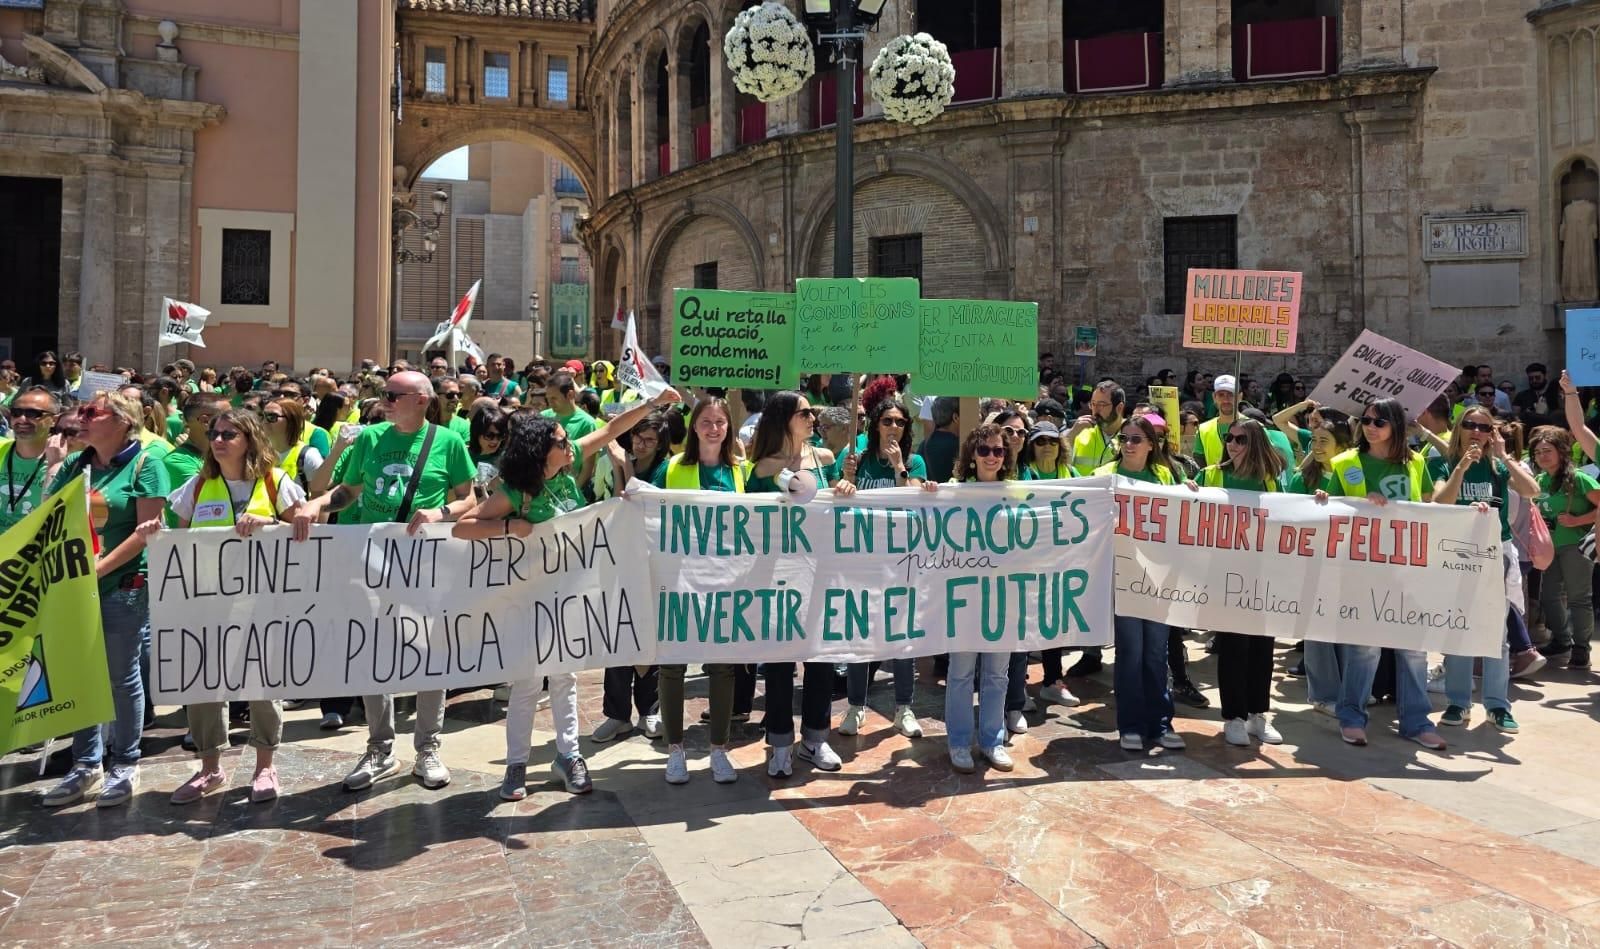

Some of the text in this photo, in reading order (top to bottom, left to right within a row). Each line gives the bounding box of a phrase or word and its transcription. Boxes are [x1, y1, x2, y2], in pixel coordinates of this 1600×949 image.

[800, 283, 887, 302] VOLEM LES
[1194, 273, 1295, 302] MILLORES
[679, 296, 787, 325] Qui retalla
[799, 299, 915, 322] CONDICIONS
[948, 304, 1037, 328] MIRACLES
[1192, 303, 1291, 326] LABORALS
[680, 319, 765, 344] educació,
[954, 333, 995, 348] ENTRA
[1002, 331, 1017, 347] AL
[1191, 325, 1290, 349] SALARIALS
[679, 338, 769, 361] condemna
[678, 363, 781, 385] generacions!
[920, 356, 1034, 385] CURRÍCULUM
[1352, 343, 1402, 370] EDUCACIÓ
[1406, 367, 1448, 393] QUALITAT
[1362, 371, 1405, 396] RATIO
[659, 491, 1091, 556] INVERTIR EN EDUCACIÓ ÉS
[1114, 493, 1429, 568] IES L'HORT DE FELIU
[159, 516, 616, 602] ALGINET UNIT PER UNA
[896, 544, 1000, 583] pública
[1442, 560, 1483, 574] ALGINET
[1115, 554, 1470, 631] Educació Pública i en Valencià
[657, 568, 1091, 644] INVERTIR EN EL FUTUR
[158, 587, 641, 693] EDUCACIÓ PÚBLICA DIGNA
[39, 699, 76, 719] (PEGO)
